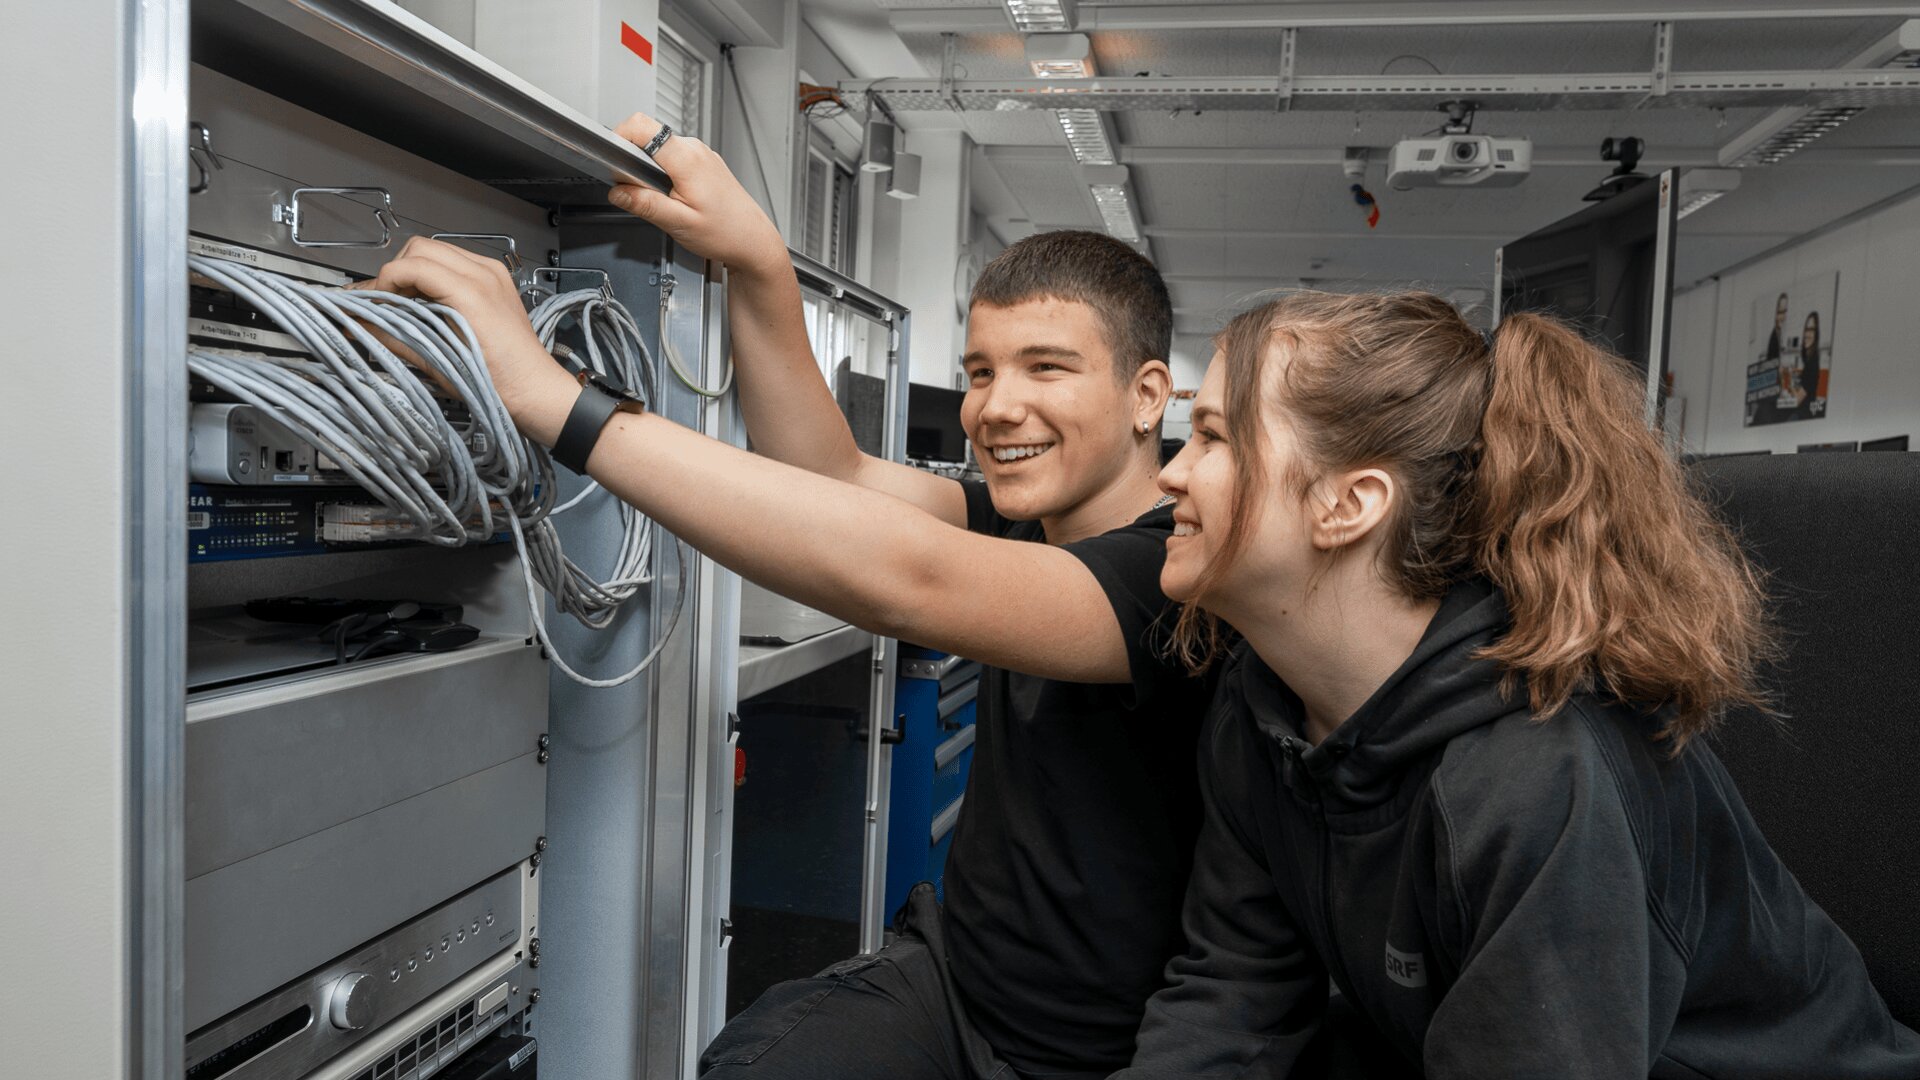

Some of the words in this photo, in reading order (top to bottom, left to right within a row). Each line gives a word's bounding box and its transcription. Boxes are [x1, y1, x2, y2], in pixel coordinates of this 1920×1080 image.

[201, 244, 241, 258] Arbeitsplätze
[243, 253, 257, 262] 1-12
[201, 324, 241, 337] Arbeitsplätze
[243, 332, 257, 340] 1-12
[188, 496, 213, 506] EAR
[1386, 951, 1418, 979] SRF
